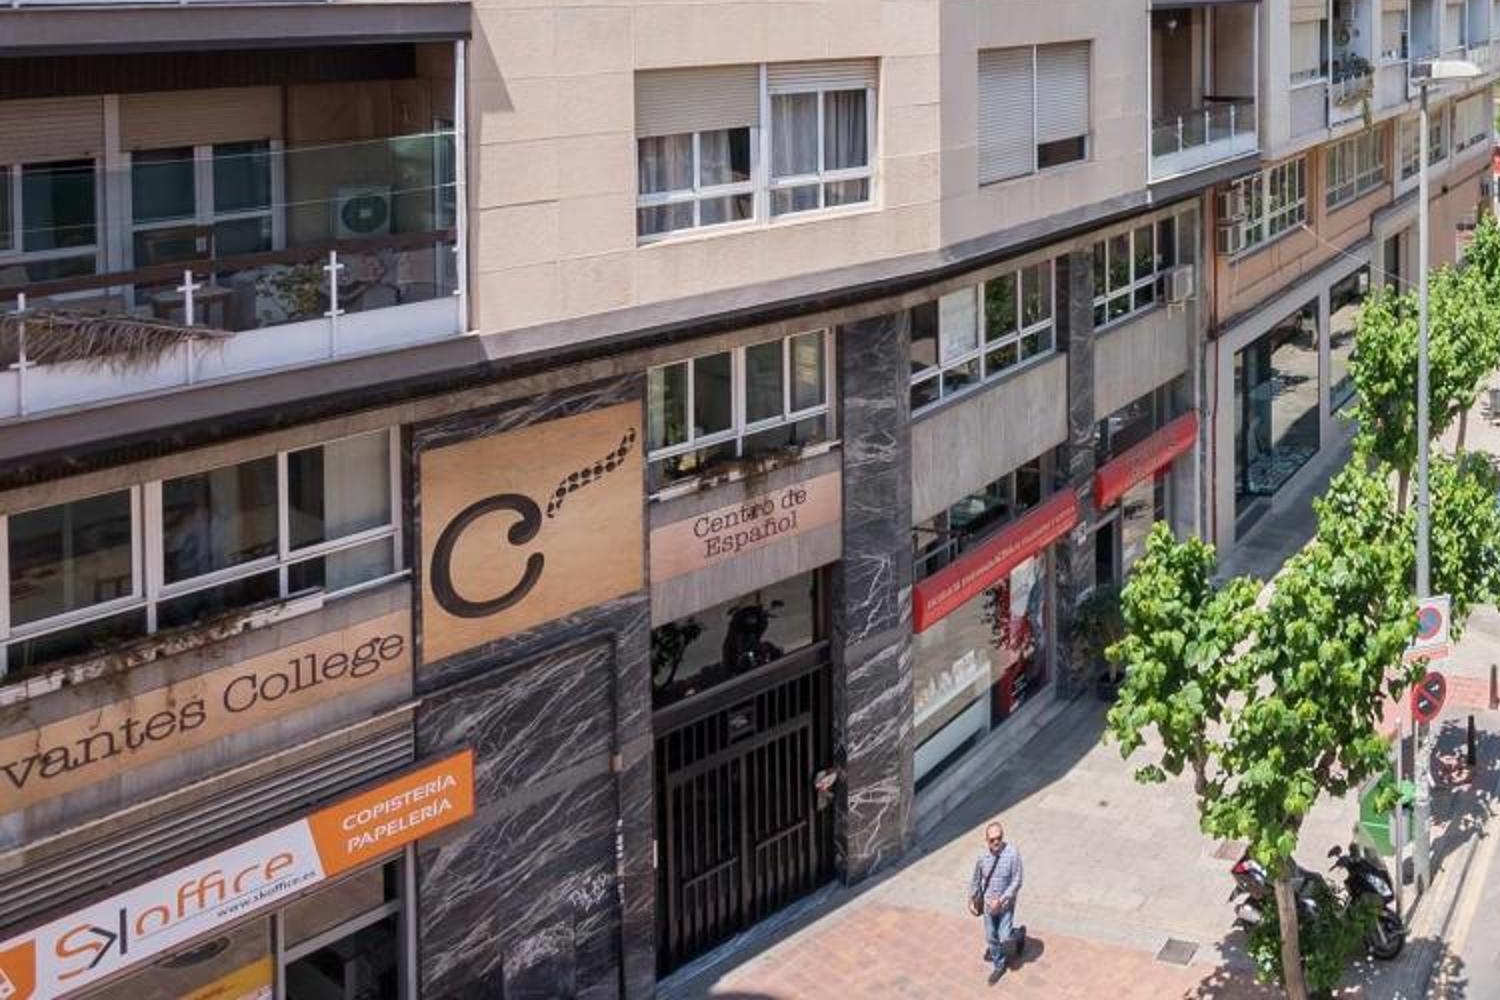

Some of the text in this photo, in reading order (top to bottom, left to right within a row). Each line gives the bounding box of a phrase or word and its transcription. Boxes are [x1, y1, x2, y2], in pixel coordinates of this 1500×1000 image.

[693, 488, 807, 539] Centro de
[704, 511, 799, 559] Español
[223, 633, 404, 713] College
[343, 775, 457, 831] COPISTERÍA
[348, 798, 452, 854] PAPELERÍA
